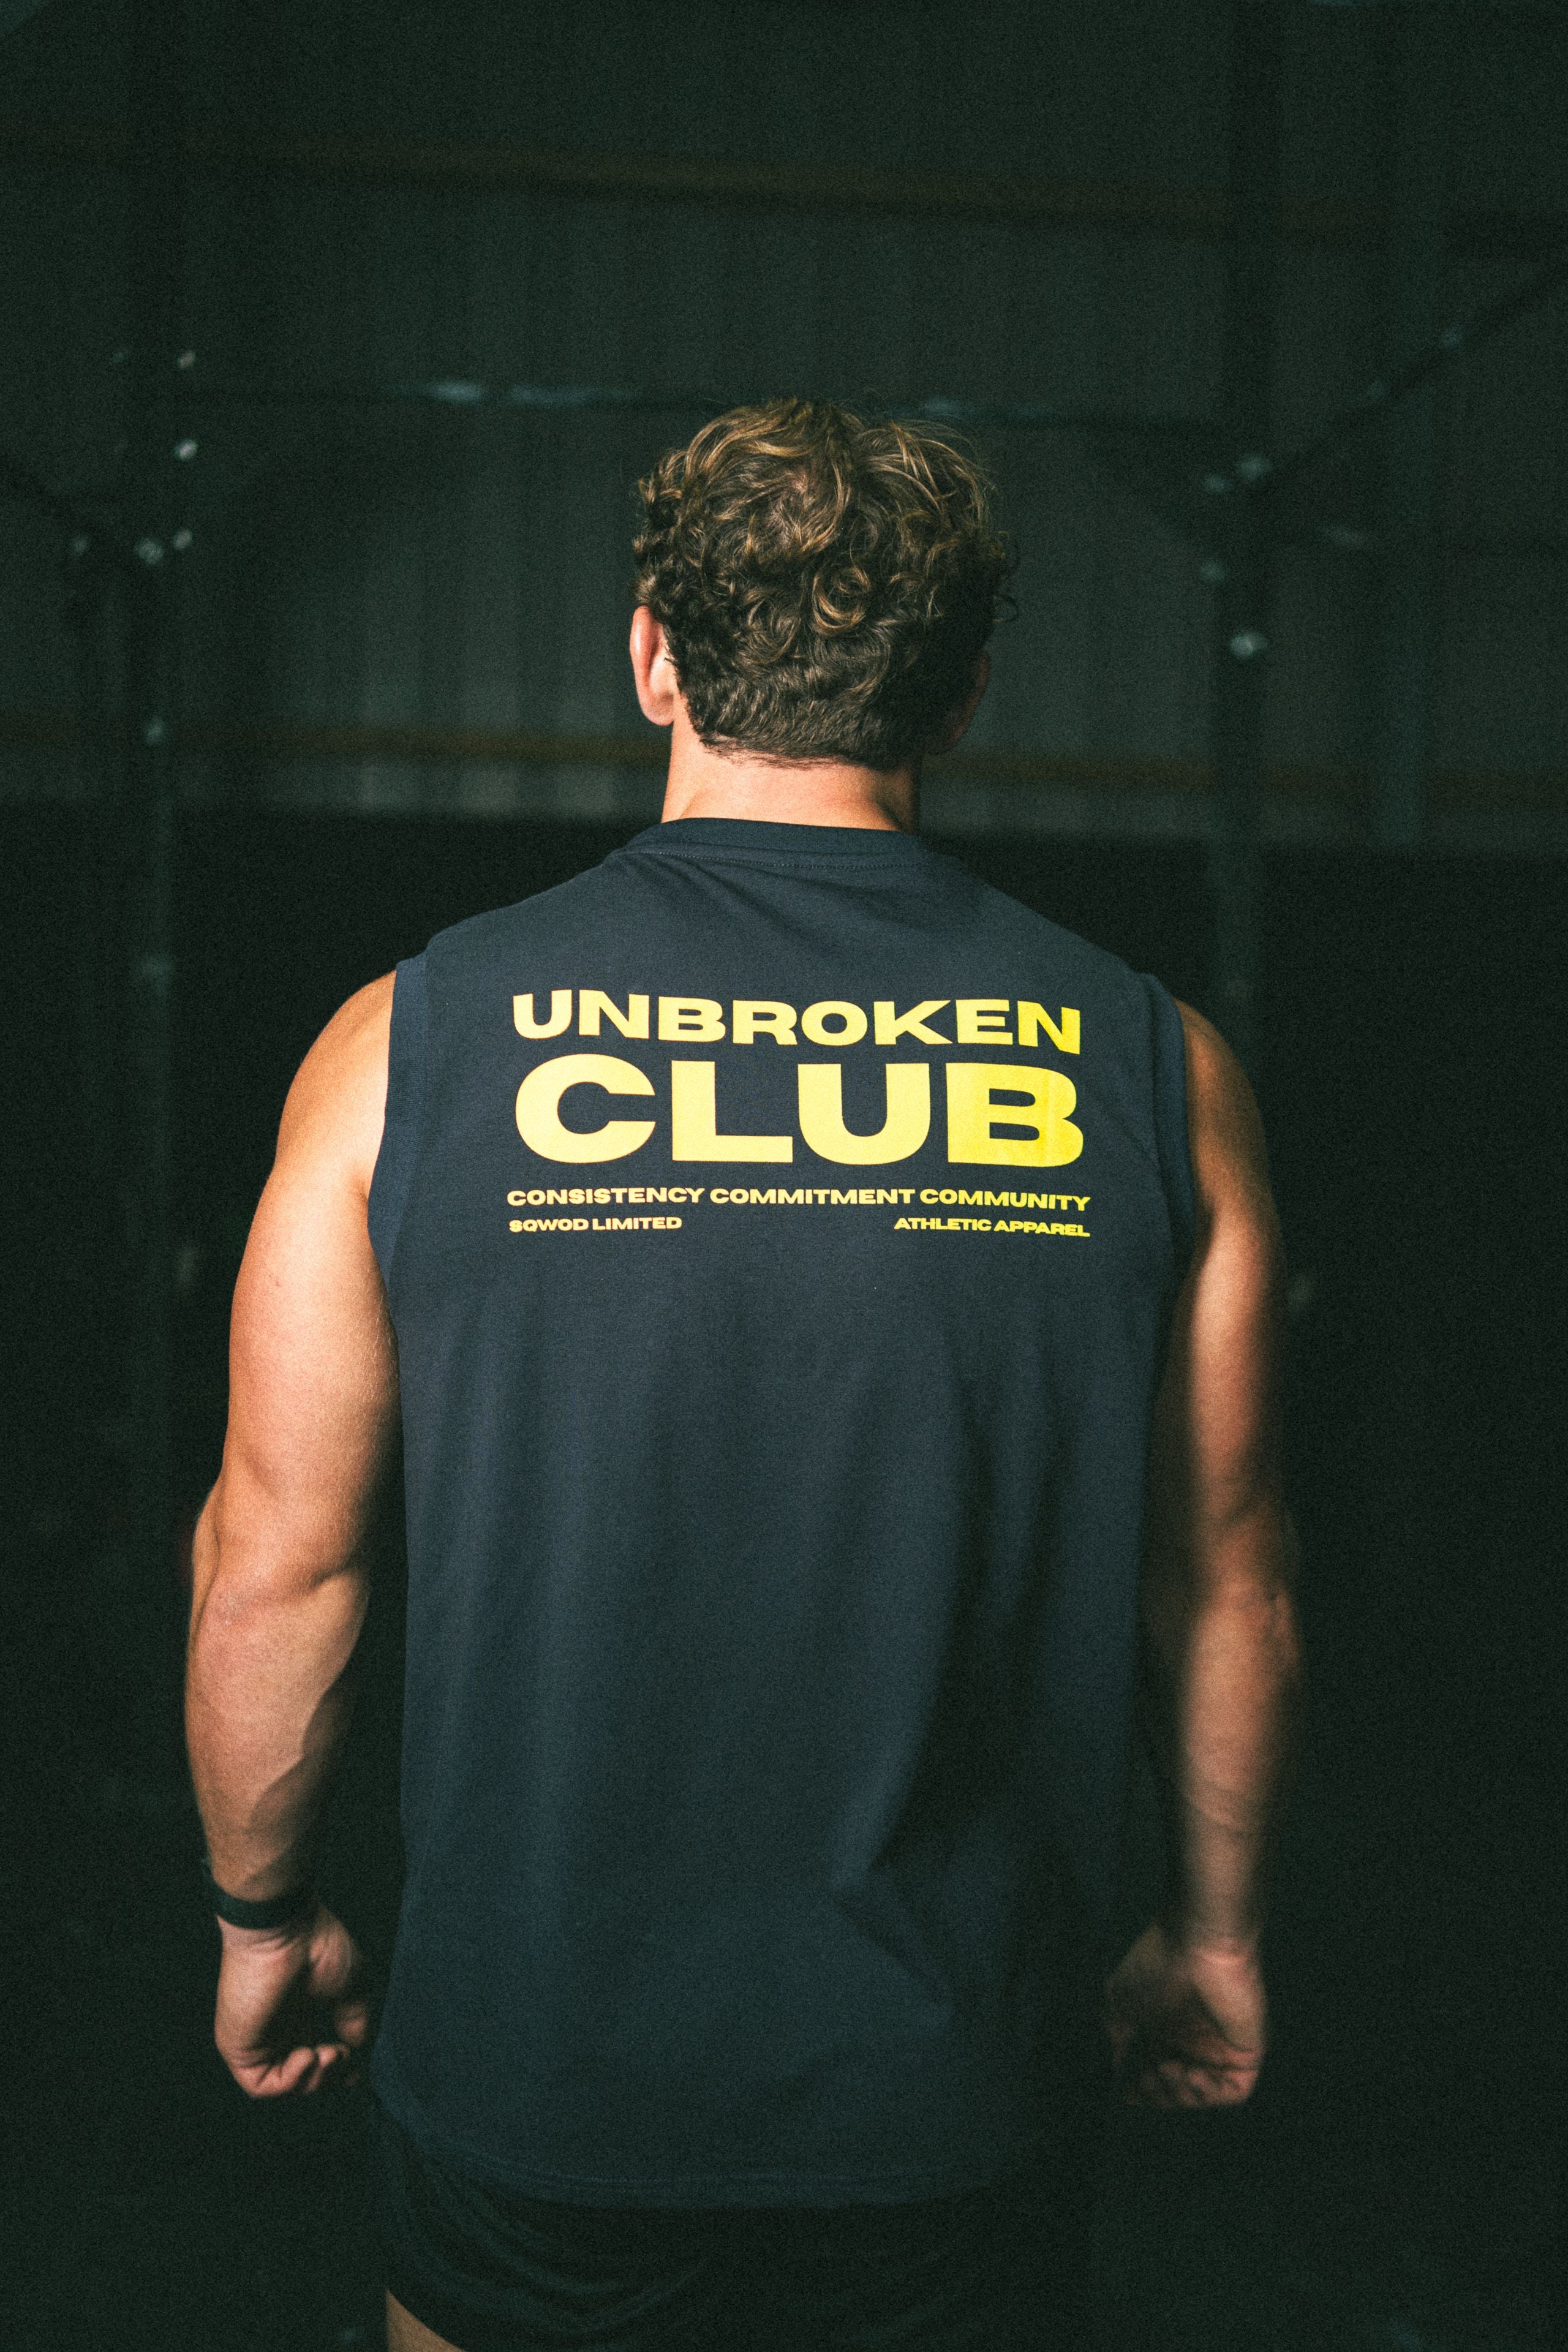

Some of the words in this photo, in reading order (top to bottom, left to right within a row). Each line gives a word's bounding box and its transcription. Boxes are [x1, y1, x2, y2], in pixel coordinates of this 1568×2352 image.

[512, 989, 1082, 1055] UNBROKEN
[514, 1053, 1084, 1168] CLUB
[507, 1187, 704, 1207] CONSISTENCY
[709, 1188, 916, 1205] COMMITMENT
[919, 1188, 1091, 1212] COMMUNITY
[509, 1218, 589, 1233] SQWOD
[592, 1216, 683, 1231] LIMITED
[893, 1217, 992, 1232] ATHLETIC
[993, 1219, 1091, 1237] APPAREL
